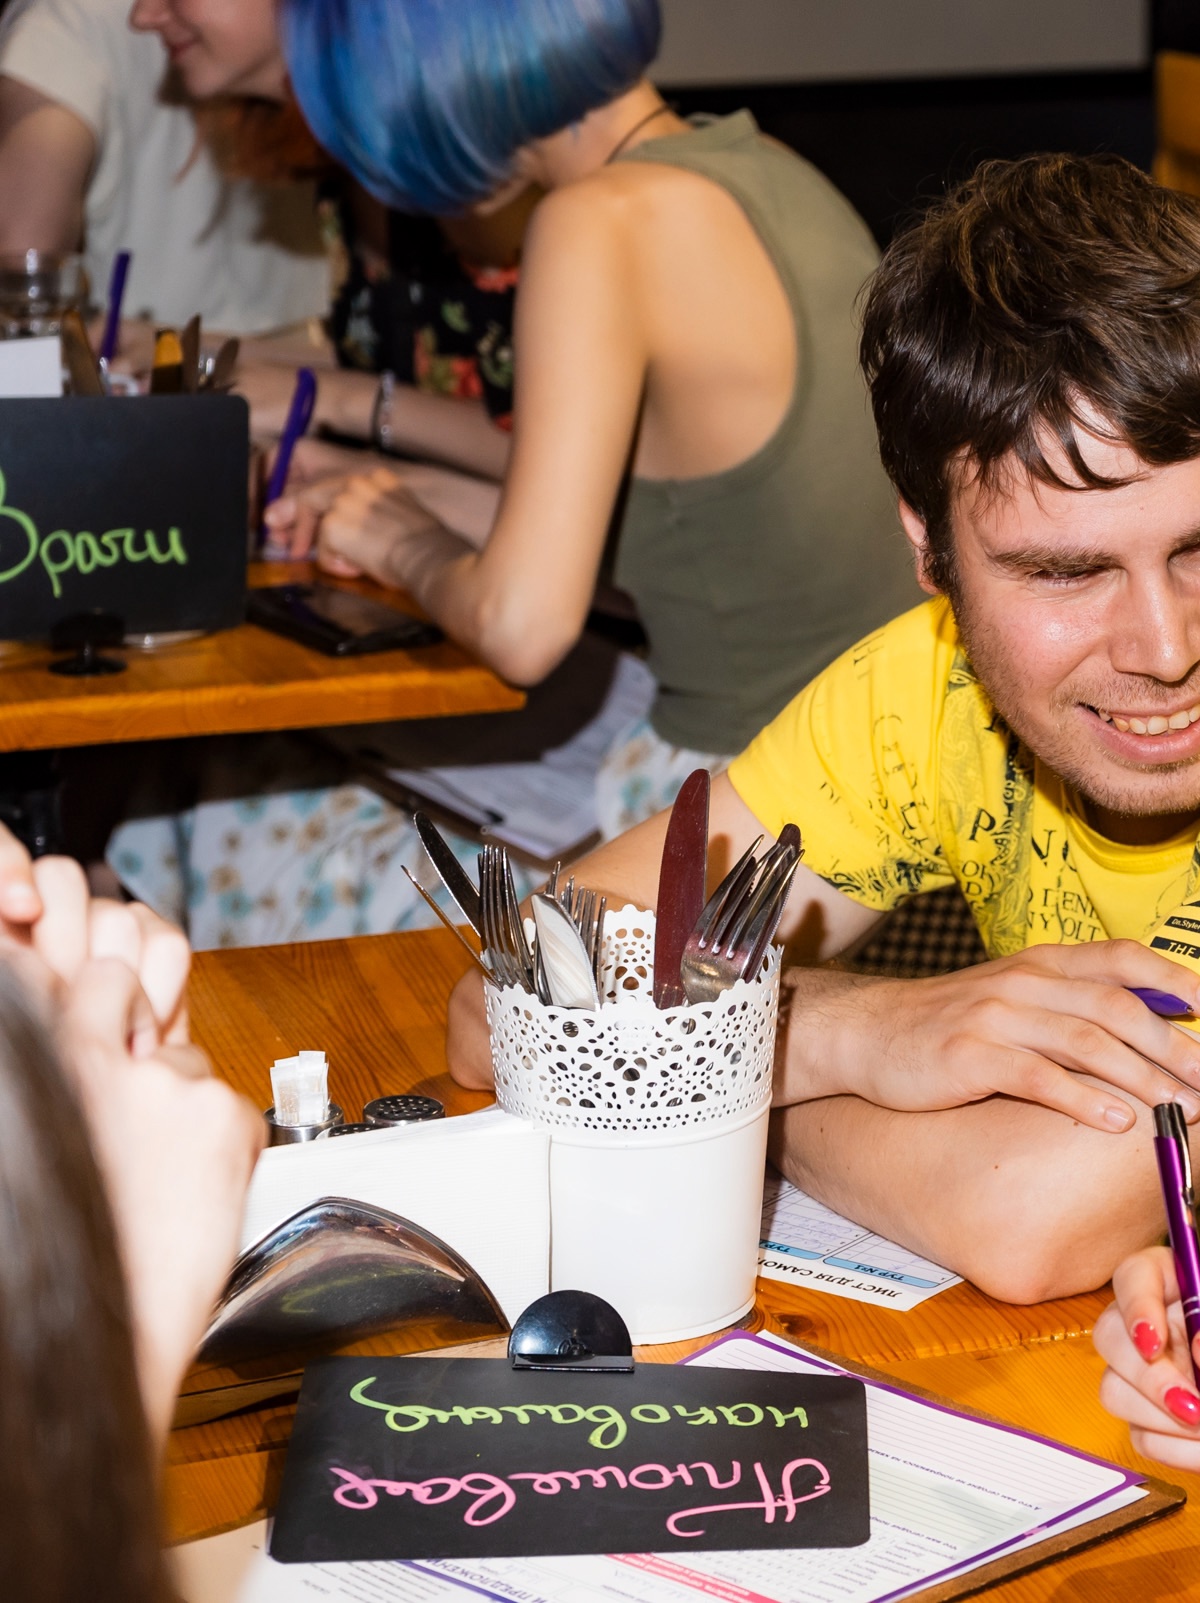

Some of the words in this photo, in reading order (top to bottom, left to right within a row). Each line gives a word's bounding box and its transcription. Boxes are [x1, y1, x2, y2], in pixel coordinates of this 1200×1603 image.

[1167, 941, 1198, 957] THE
[813, 1272, 852, 1286] ДЛЯ
[878, 1270, 905, 1280] ТУР
[851, 1282, 902, 1298] ЛИСТ
[426, 1558, 531, 1599] ПРЕДЛОЖЕНИ
